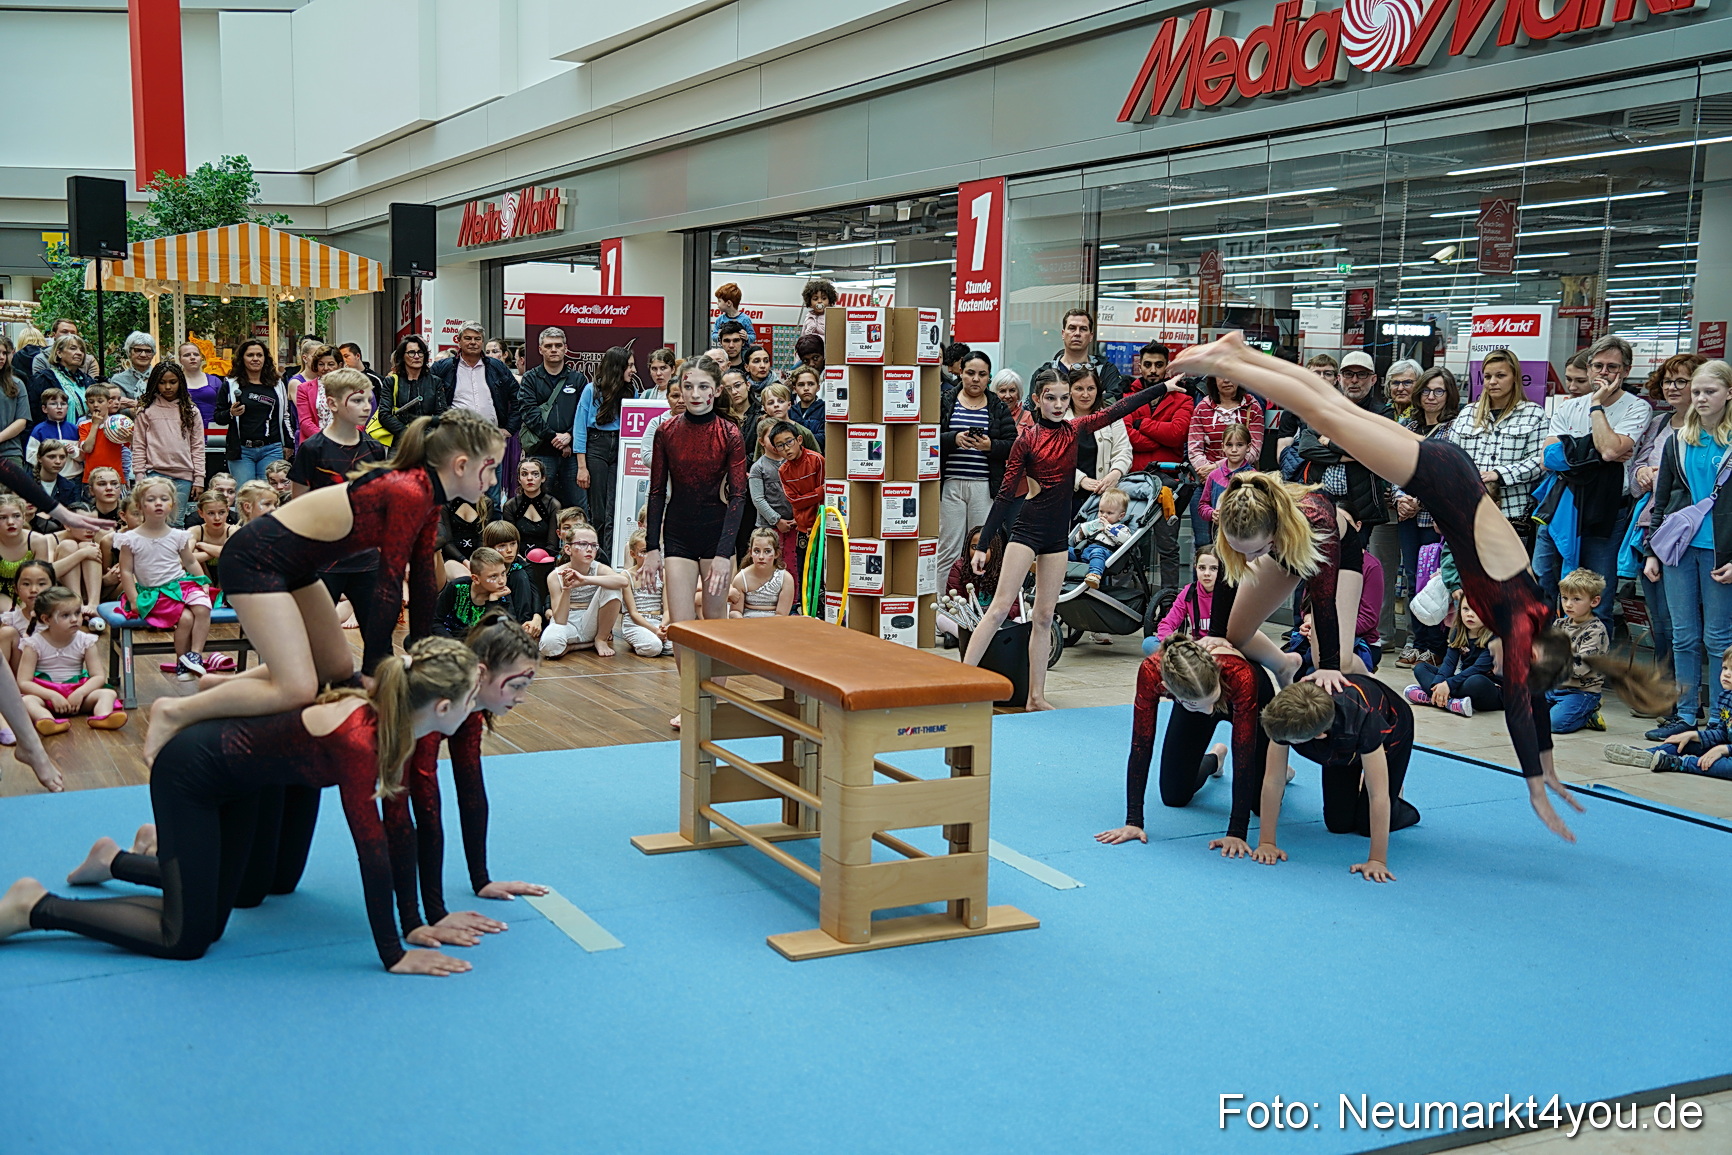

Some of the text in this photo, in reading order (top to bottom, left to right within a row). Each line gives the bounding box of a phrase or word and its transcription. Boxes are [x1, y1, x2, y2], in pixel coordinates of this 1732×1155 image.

[971, 192, 993, 272] 1
[606, 247, 617, 296] 1
[964, 279, 992, 295] Stunde
[576, 316, 614, 325] PRÄSENTIERT
[848, 312, 876, 320] Mietservice
[1382, 323, 1431, 337] SAMSUNG
[1158, 331, 1195, 341] DVD Filme
[1106, 343, 1127, 352] Blu-ray
[885, 371, 912, 379] Mietservice
[884, 488, 911, 496] Mietservice
